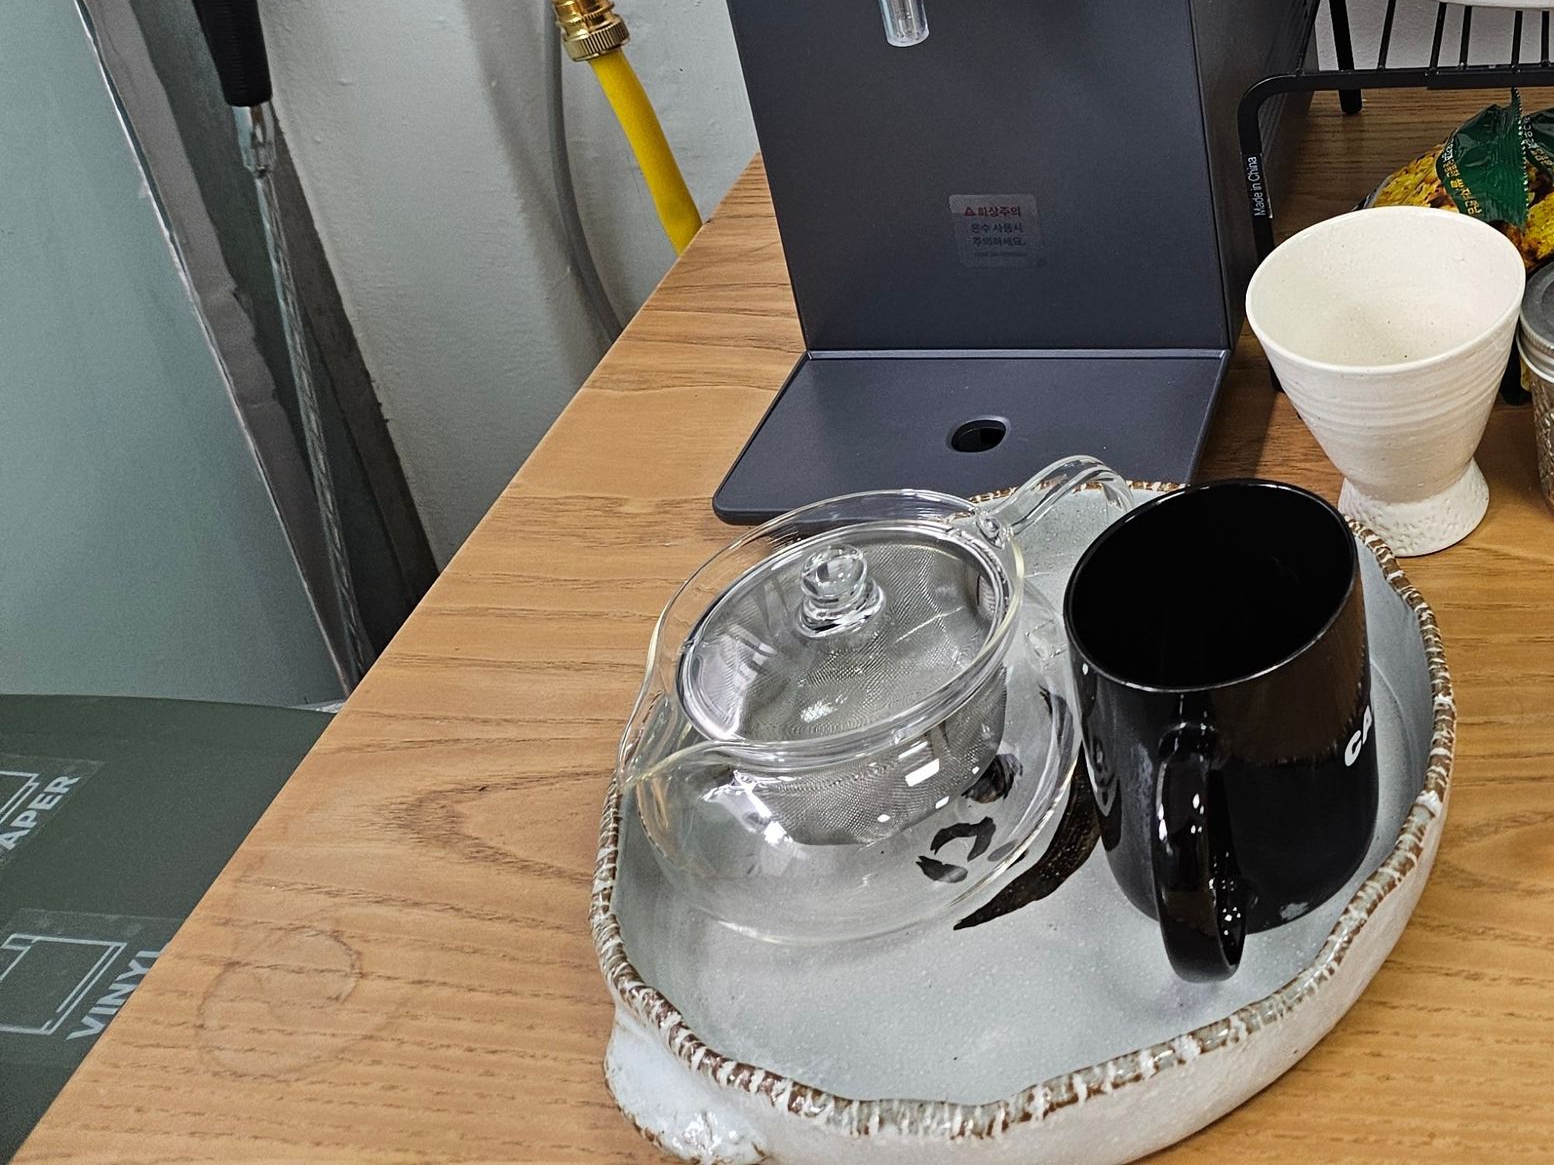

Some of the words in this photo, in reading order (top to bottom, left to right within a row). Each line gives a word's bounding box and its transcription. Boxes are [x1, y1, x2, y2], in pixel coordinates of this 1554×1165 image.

[1246, 156, 1260, 182] China
[1250, 182, 1262, 191] in
[1252, 192, 1267, 216] Made
